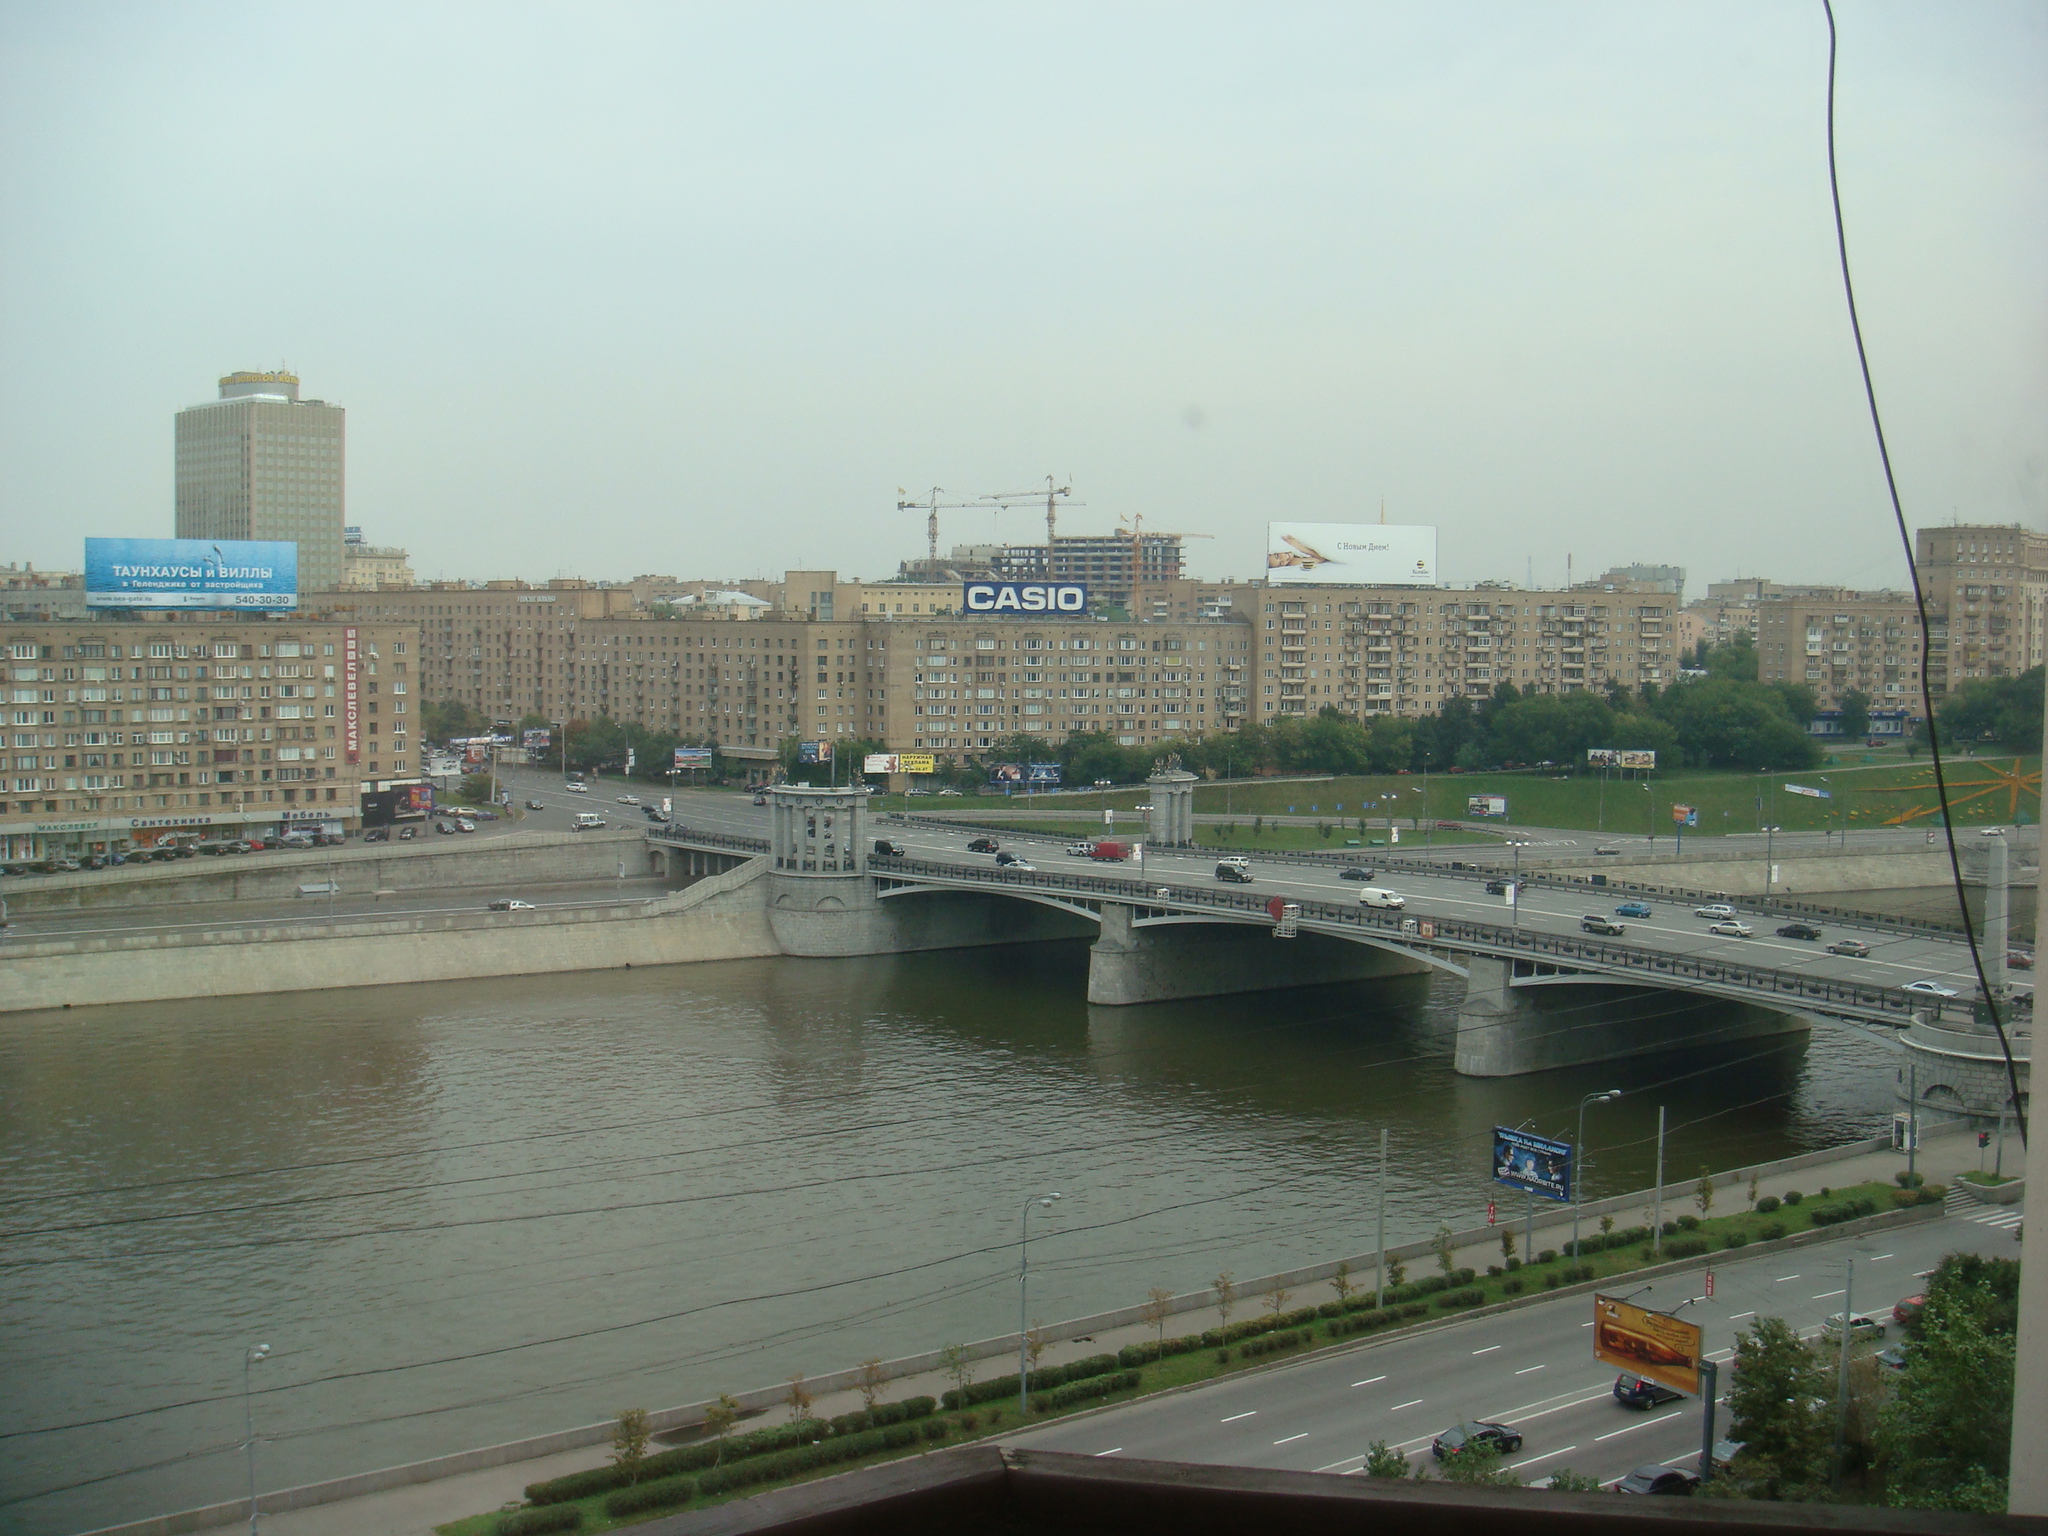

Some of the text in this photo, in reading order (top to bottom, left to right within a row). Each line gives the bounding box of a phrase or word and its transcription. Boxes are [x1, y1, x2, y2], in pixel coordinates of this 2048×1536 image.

[1368, 543, 1389, 551] Днем!
[113, 565, 272, 579] ТАУНХАУСЫ и ВИЛЛЫ
[132, 580, 186, 589] Геленджике
[205, 580, 264, 590] застройщика
[235, 596, 289, 604] 540-30-30
[967, 586, 1084, 611] CASIO
[347, 662, 358, 751] МАКСЛЕВЕЛ
[282, 811, 331, 820] Мебель
[38, 822, 98, 831] МАКСЛЕВЕЛ
[131, 817, 212, 827] Сантехника
